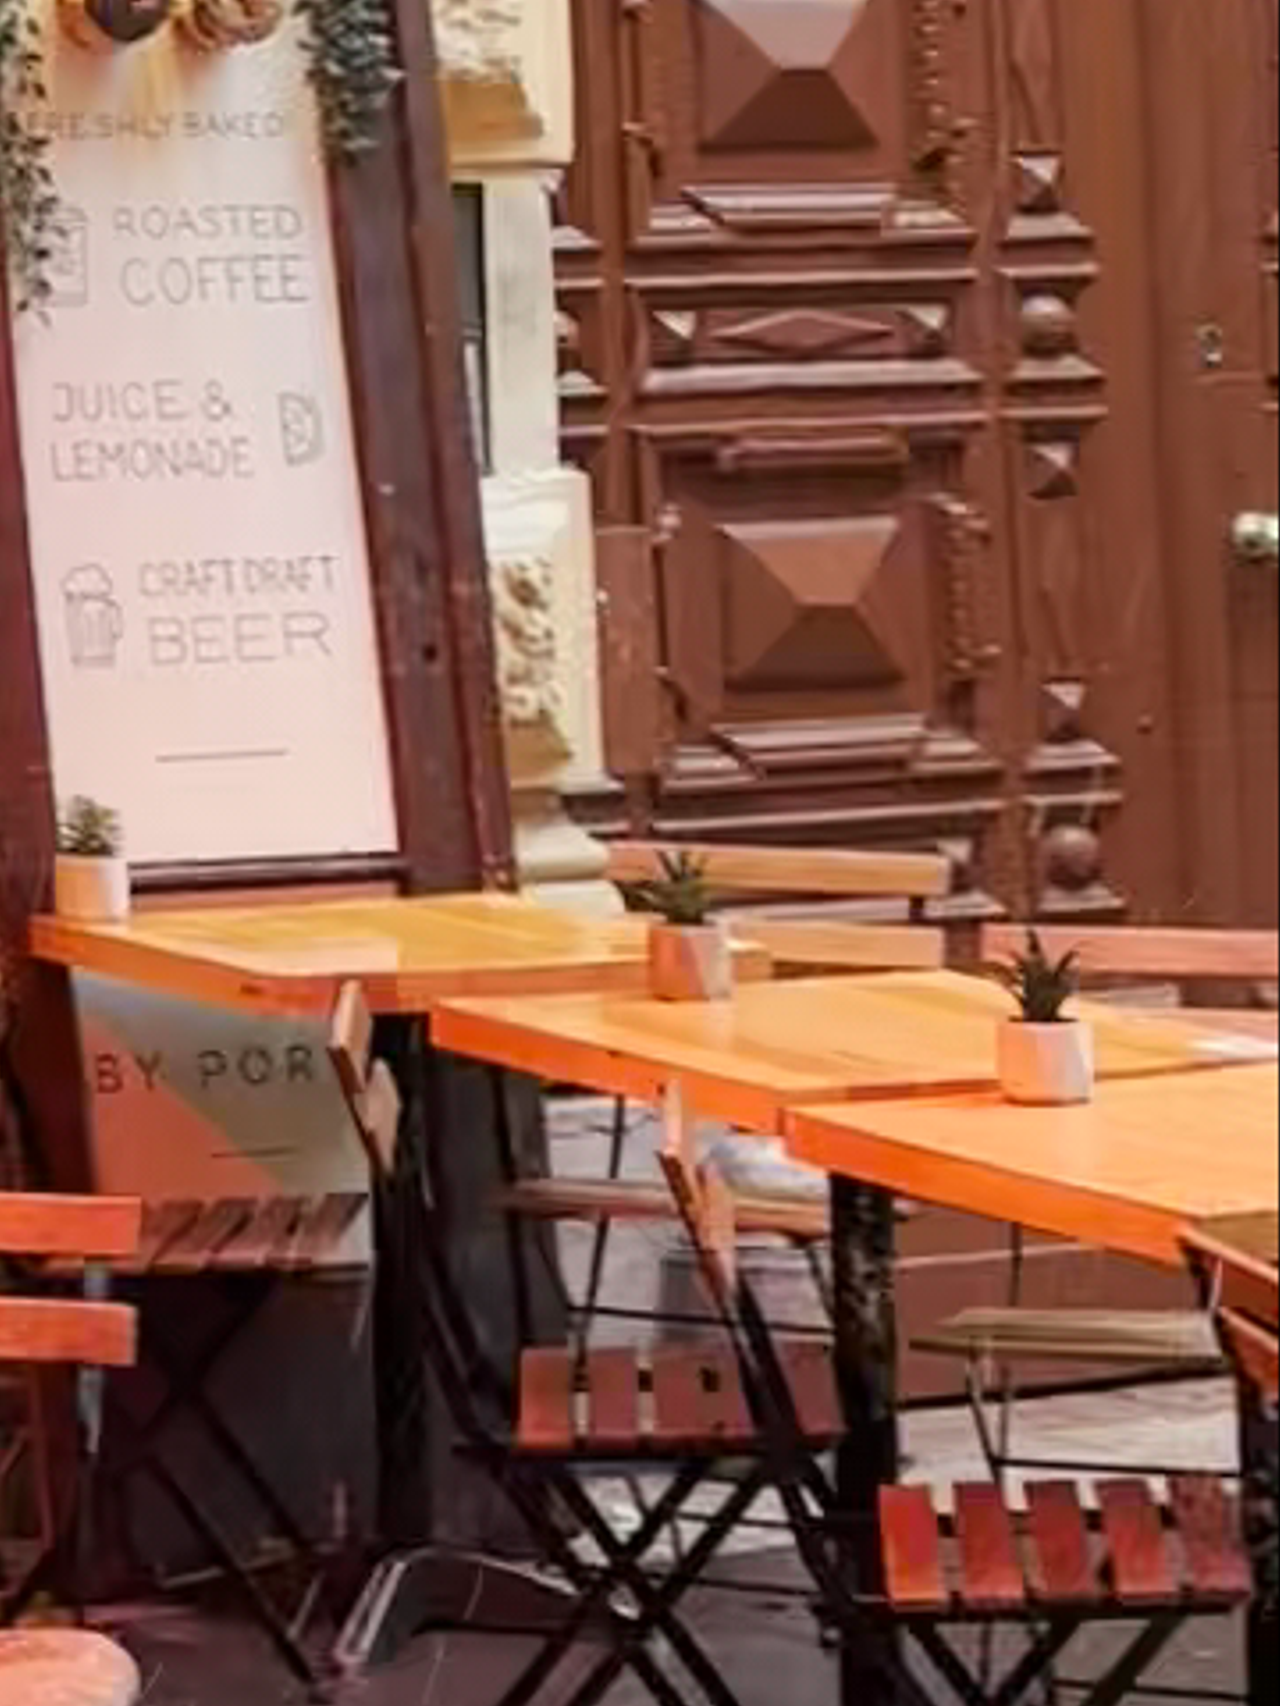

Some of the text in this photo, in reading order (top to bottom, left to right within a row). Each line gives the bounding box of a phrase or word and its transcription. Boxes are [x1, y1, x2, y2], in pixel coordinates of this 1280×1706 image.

[182, 111, 285, 140] BAKED
[112, 203, 304, 242] ROASTED
[121, 253, 309, 308] COFFEE
[51, 379, 232, 424] JUICE &
[50, 435, 255, 483] LEMONADE
[138, 554, 341, 598] CRAFT DRAFT
[146, 612, 336, 666] BEER
[95, 1049, 163, 1094] BY
